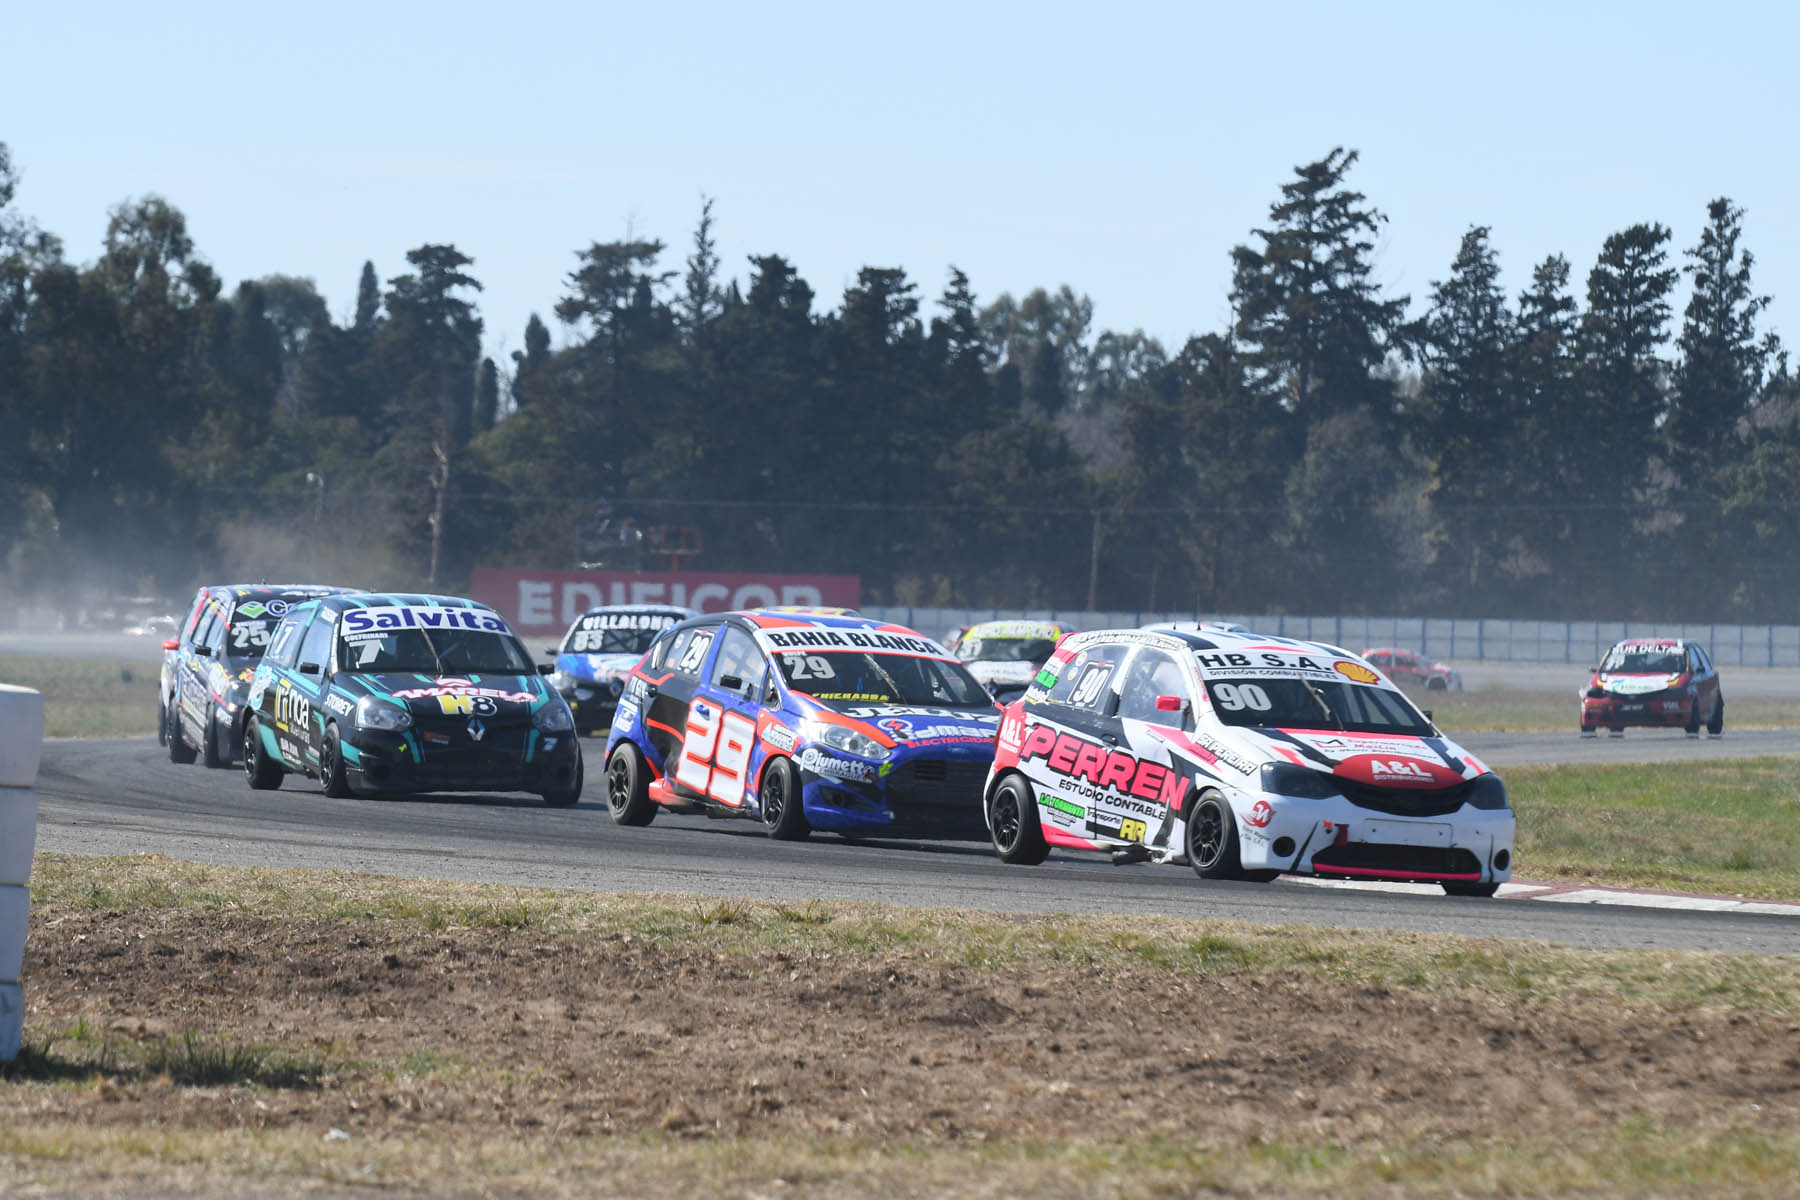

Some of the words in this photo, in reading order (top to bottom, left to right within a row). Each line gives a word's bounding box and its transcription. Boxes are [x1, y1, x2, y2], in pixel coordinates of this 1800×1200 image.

[344, 608, 507, 632] Salvita
[230, 623, 270, 649] 25
[767, 632, 848, 647] BAHIA
[846, 632, 943, 655] BLANCA
[349, 638, 384, 668] 7
[680, 635, 710, 670] 29
[1197, 653, 1252, 668] HB
[1260, 653, 1332, 671] S.A.
[782, 655, 837, 680] 29
[1073, 668, 1109, 704] 90
[1213, 683, 1272, 711] 90
[324, 693, 355, 717] STOREY
[1000, 716, 1022, 747] A&L
[676, 696, 757, 808] 29
[1019, 723, 1191, 811] PERREN
[1371, 759, 1433, 777] A&L
[1058, 779, 1104, 802] ESTUDIO
[1105, 795, 1166, 821] CONTABLE
[1120, 818, 1147, 844] RR
